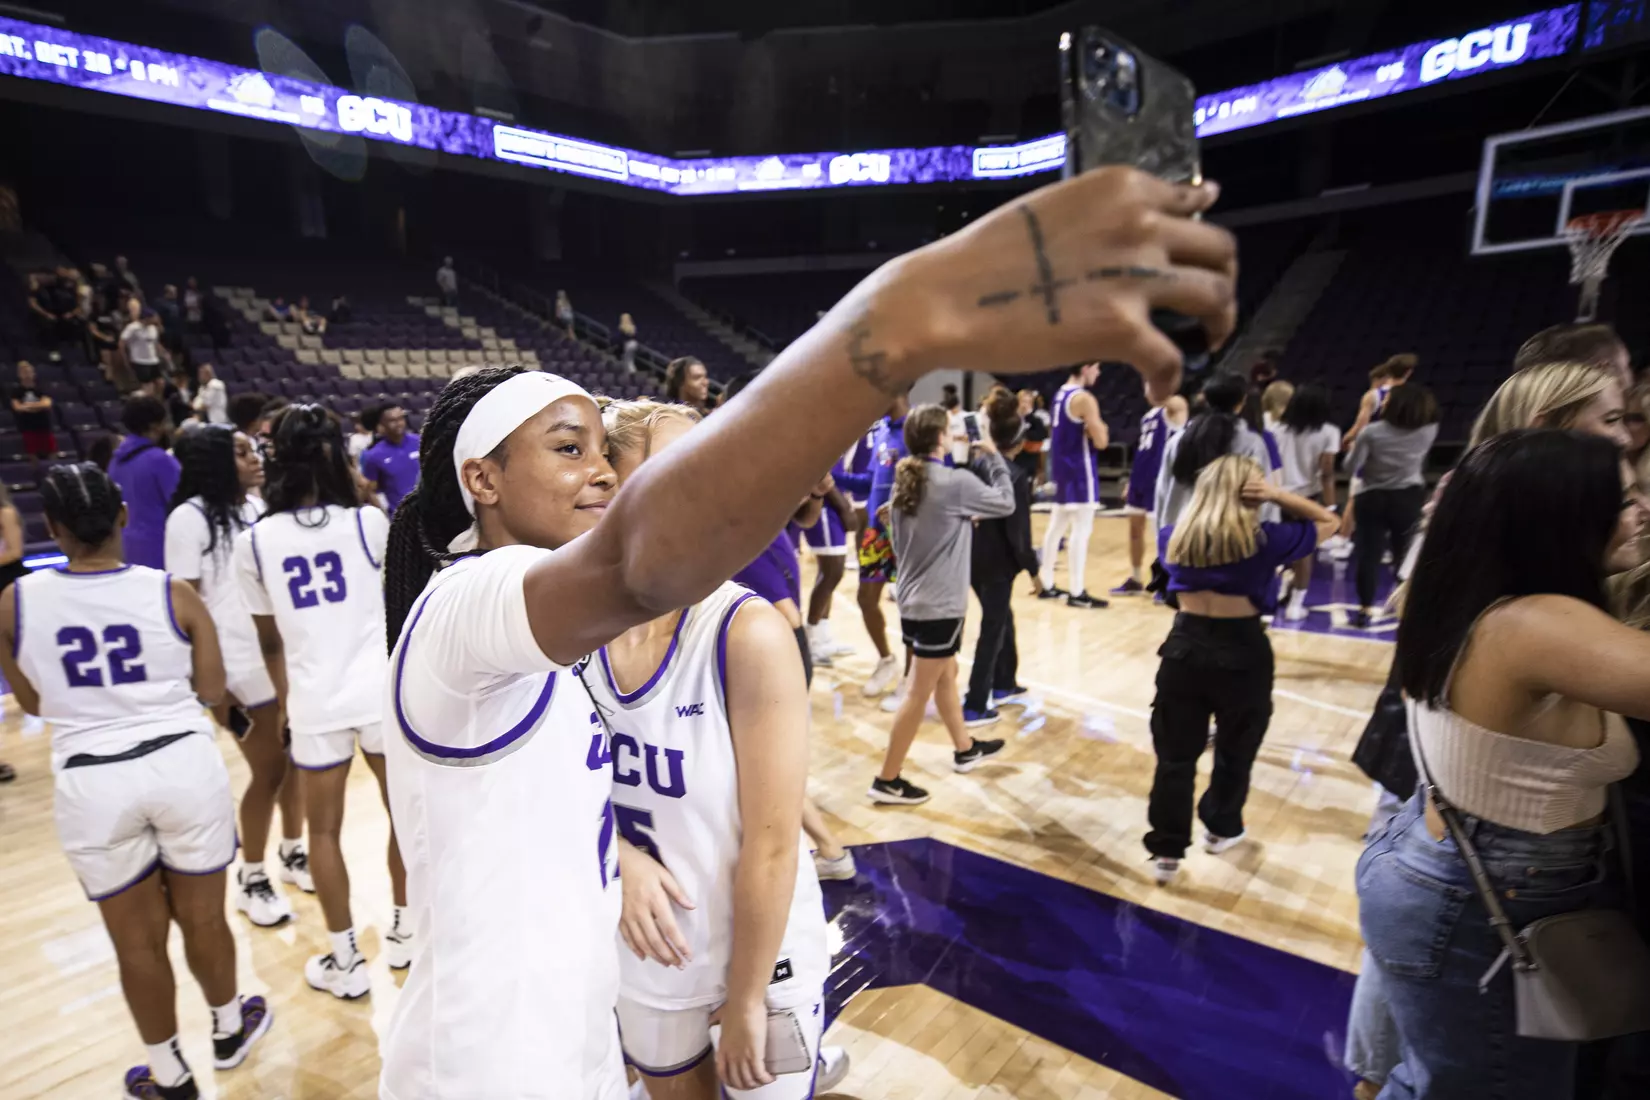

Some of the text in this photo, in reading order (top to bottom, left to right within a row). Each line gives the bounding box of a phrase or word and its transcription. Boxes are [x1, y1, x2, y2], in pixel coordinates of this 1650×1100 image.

[34, 41, 79, 68] OCT
[1419, 23, 1532, 83] GCU
[336, 95, 412, 142] GCU
[282, 550, 347, 610] 23
[56, 623, 148, 688] 22
